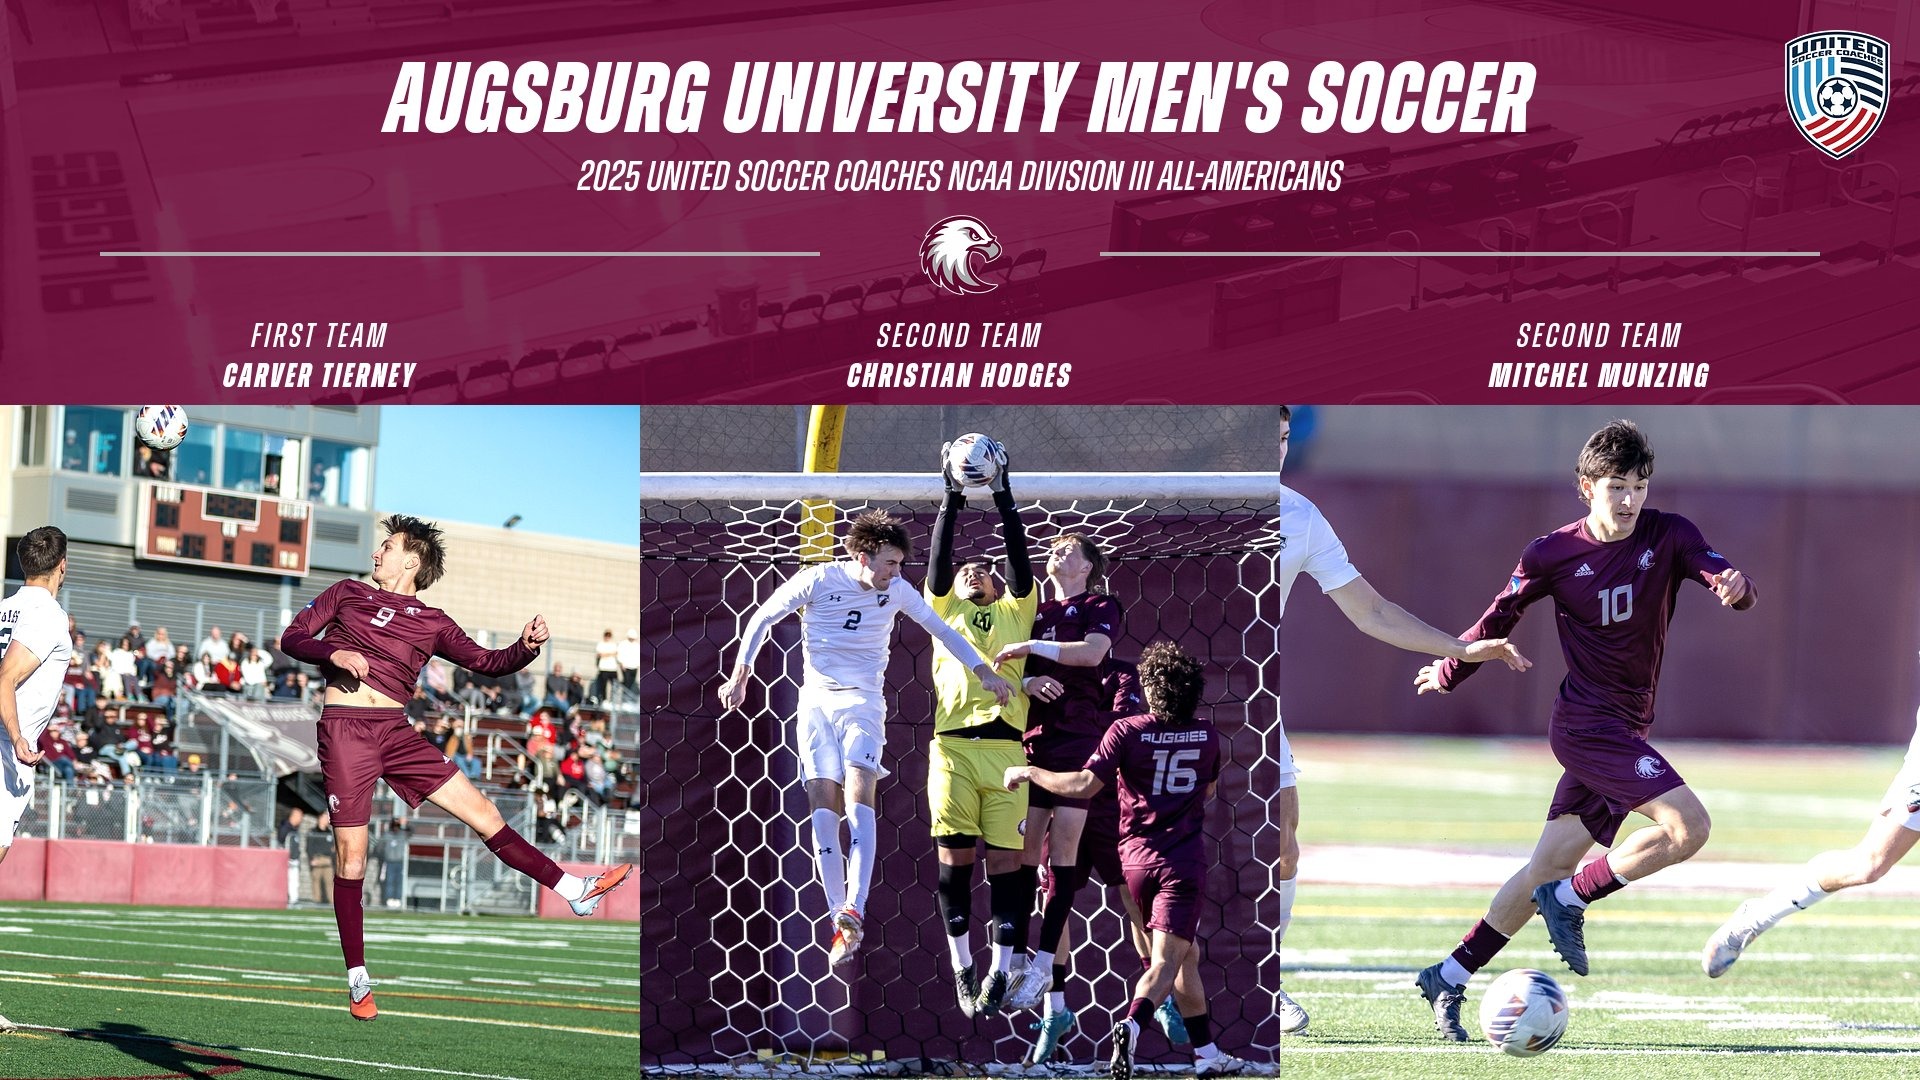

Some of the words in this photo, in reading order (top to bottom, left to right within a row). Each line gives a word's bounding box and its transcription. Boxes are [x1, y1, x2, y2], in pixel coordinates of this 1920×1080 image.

[1598, 583, 1633, 626] 10
[370, 607, 397, 628] 9
[842, 610, 862, 631] 2
[1141, 730, 1208, 744] AUGGIES
[1152, 748, 1201, 796] 16
